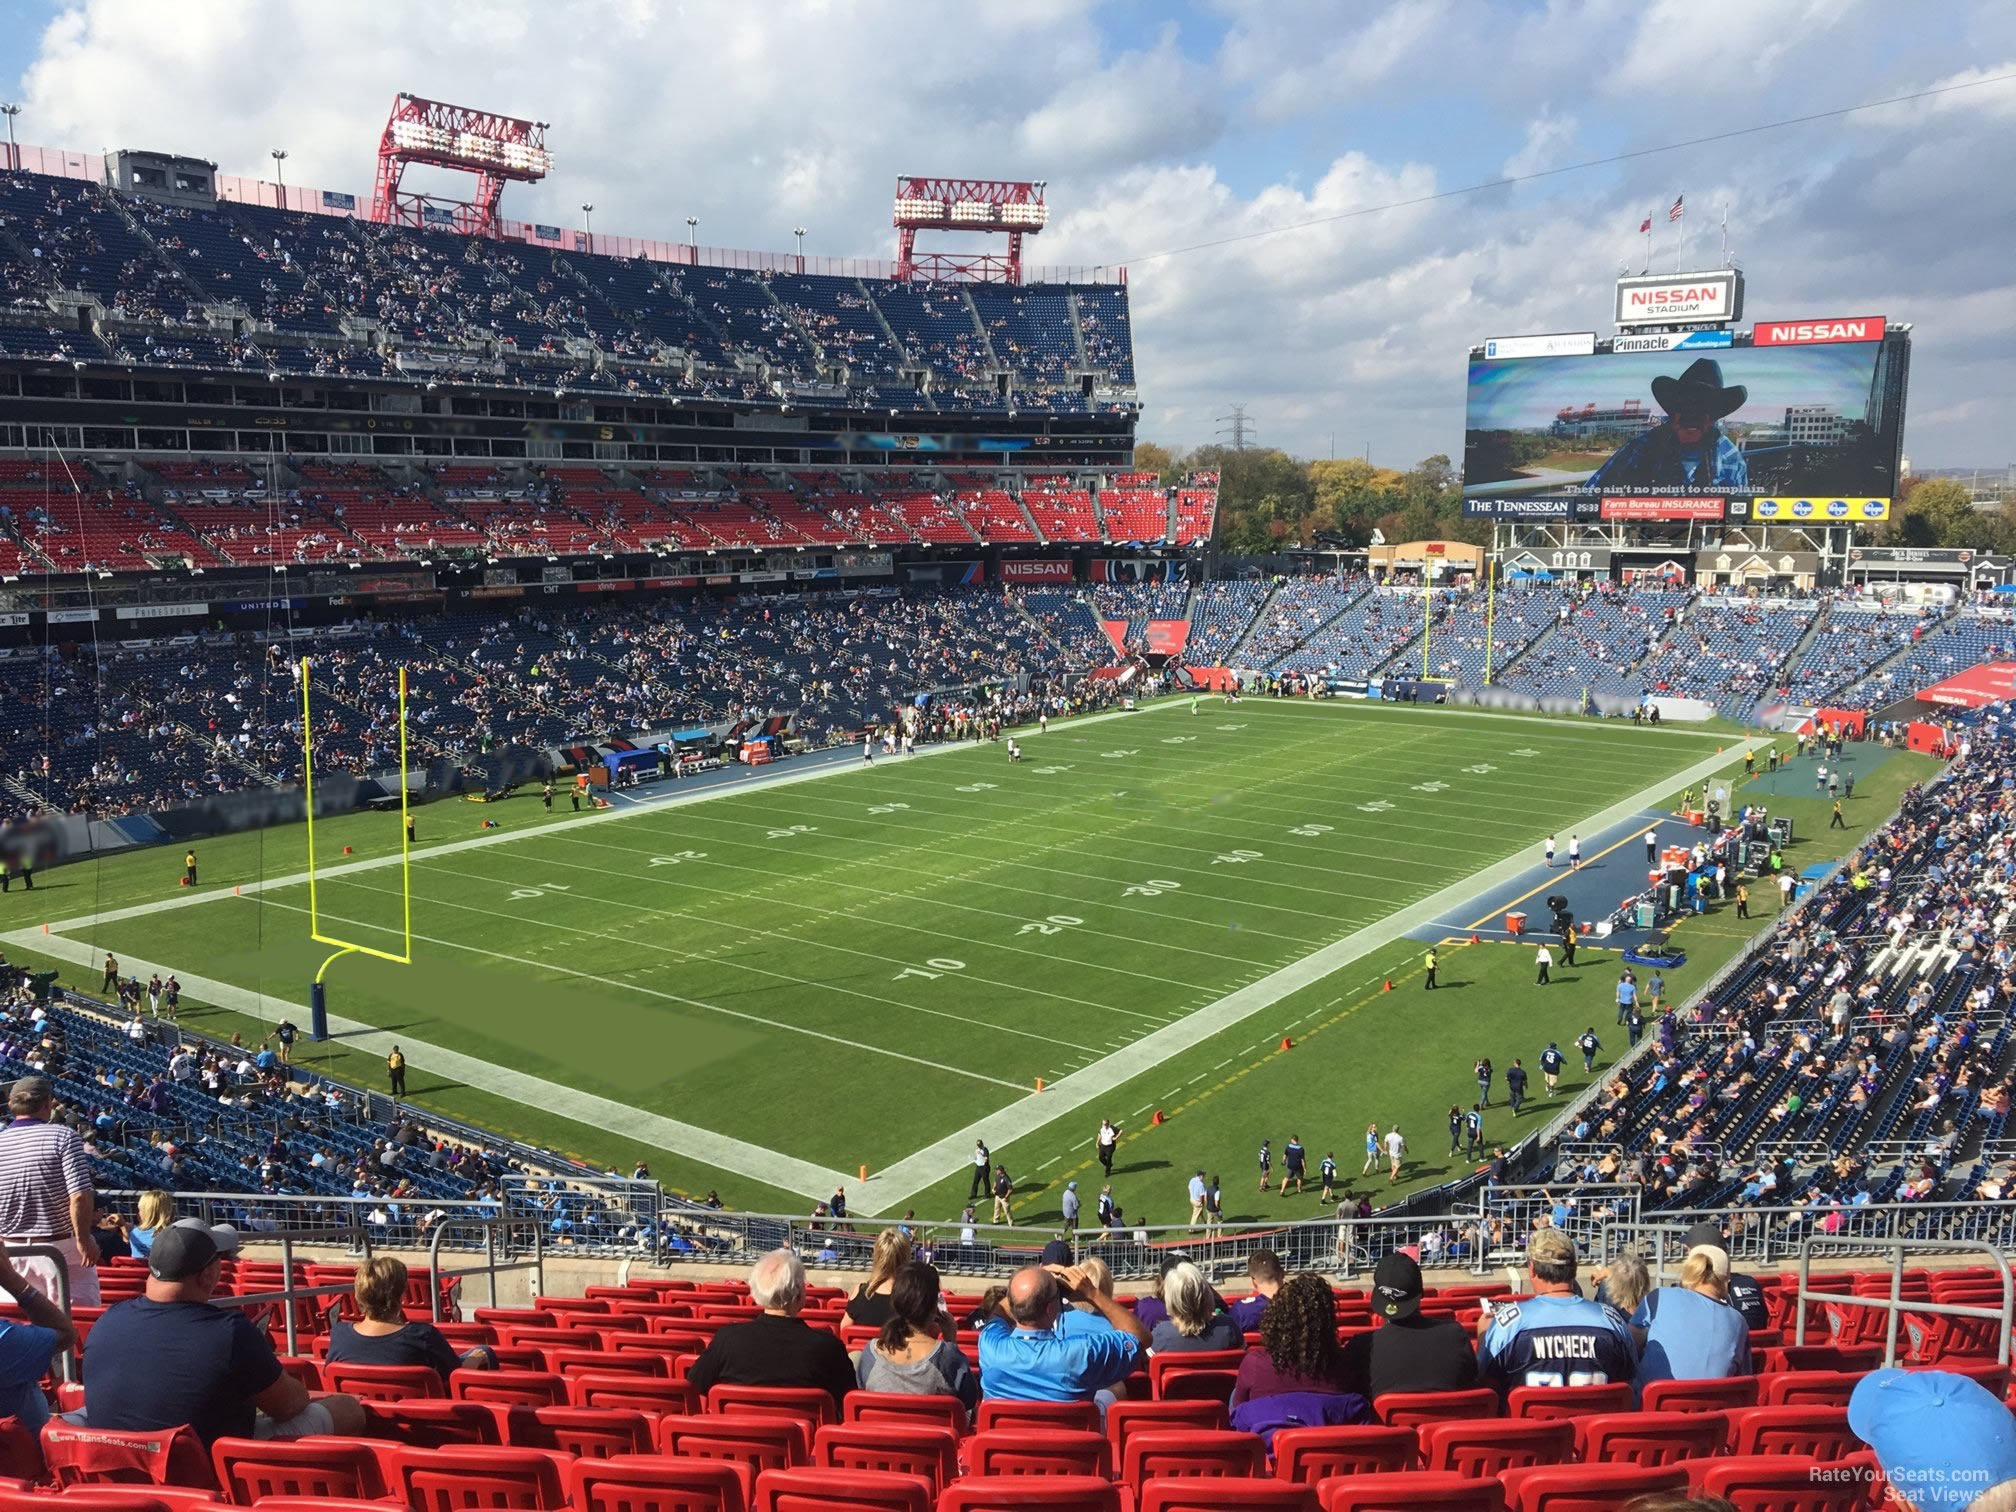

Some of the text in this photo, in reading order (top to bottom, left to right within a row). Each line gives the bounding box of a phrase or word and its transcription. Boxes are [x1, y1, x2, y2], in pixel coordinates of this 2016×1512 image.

[1631, 287, 1717, 305] NISSAN
[1647, 304, 1700, 314] STADIUM
[1771, 322, 1866, 341] NISSAN
[1615, 336, 1669, 351] Pinnacle
[1564, 485, 1765, 495] There ain't no point to complain
[1469, 500, 1569, 512] THE TENNESSEAN
[1577, 504, 1599, 512] 25:33
[1604, 500, 1720, 509] Farm Bureau INSURANCE
[1004, 563, 1068, 575] NISSAN
[543, 585, 559, 594] CMT
[241, 601, 279, 610] UNITED
[1287, 823, 1335, 836] 50
[1214, 849, 1264, 864] 40
[1124, 880, 1181, 897] 30
[1018, 915, 1084, 936] 20
[896, 957, 967, 981] 10
[1533, 1335, 1598, 1360] WYCHECK
